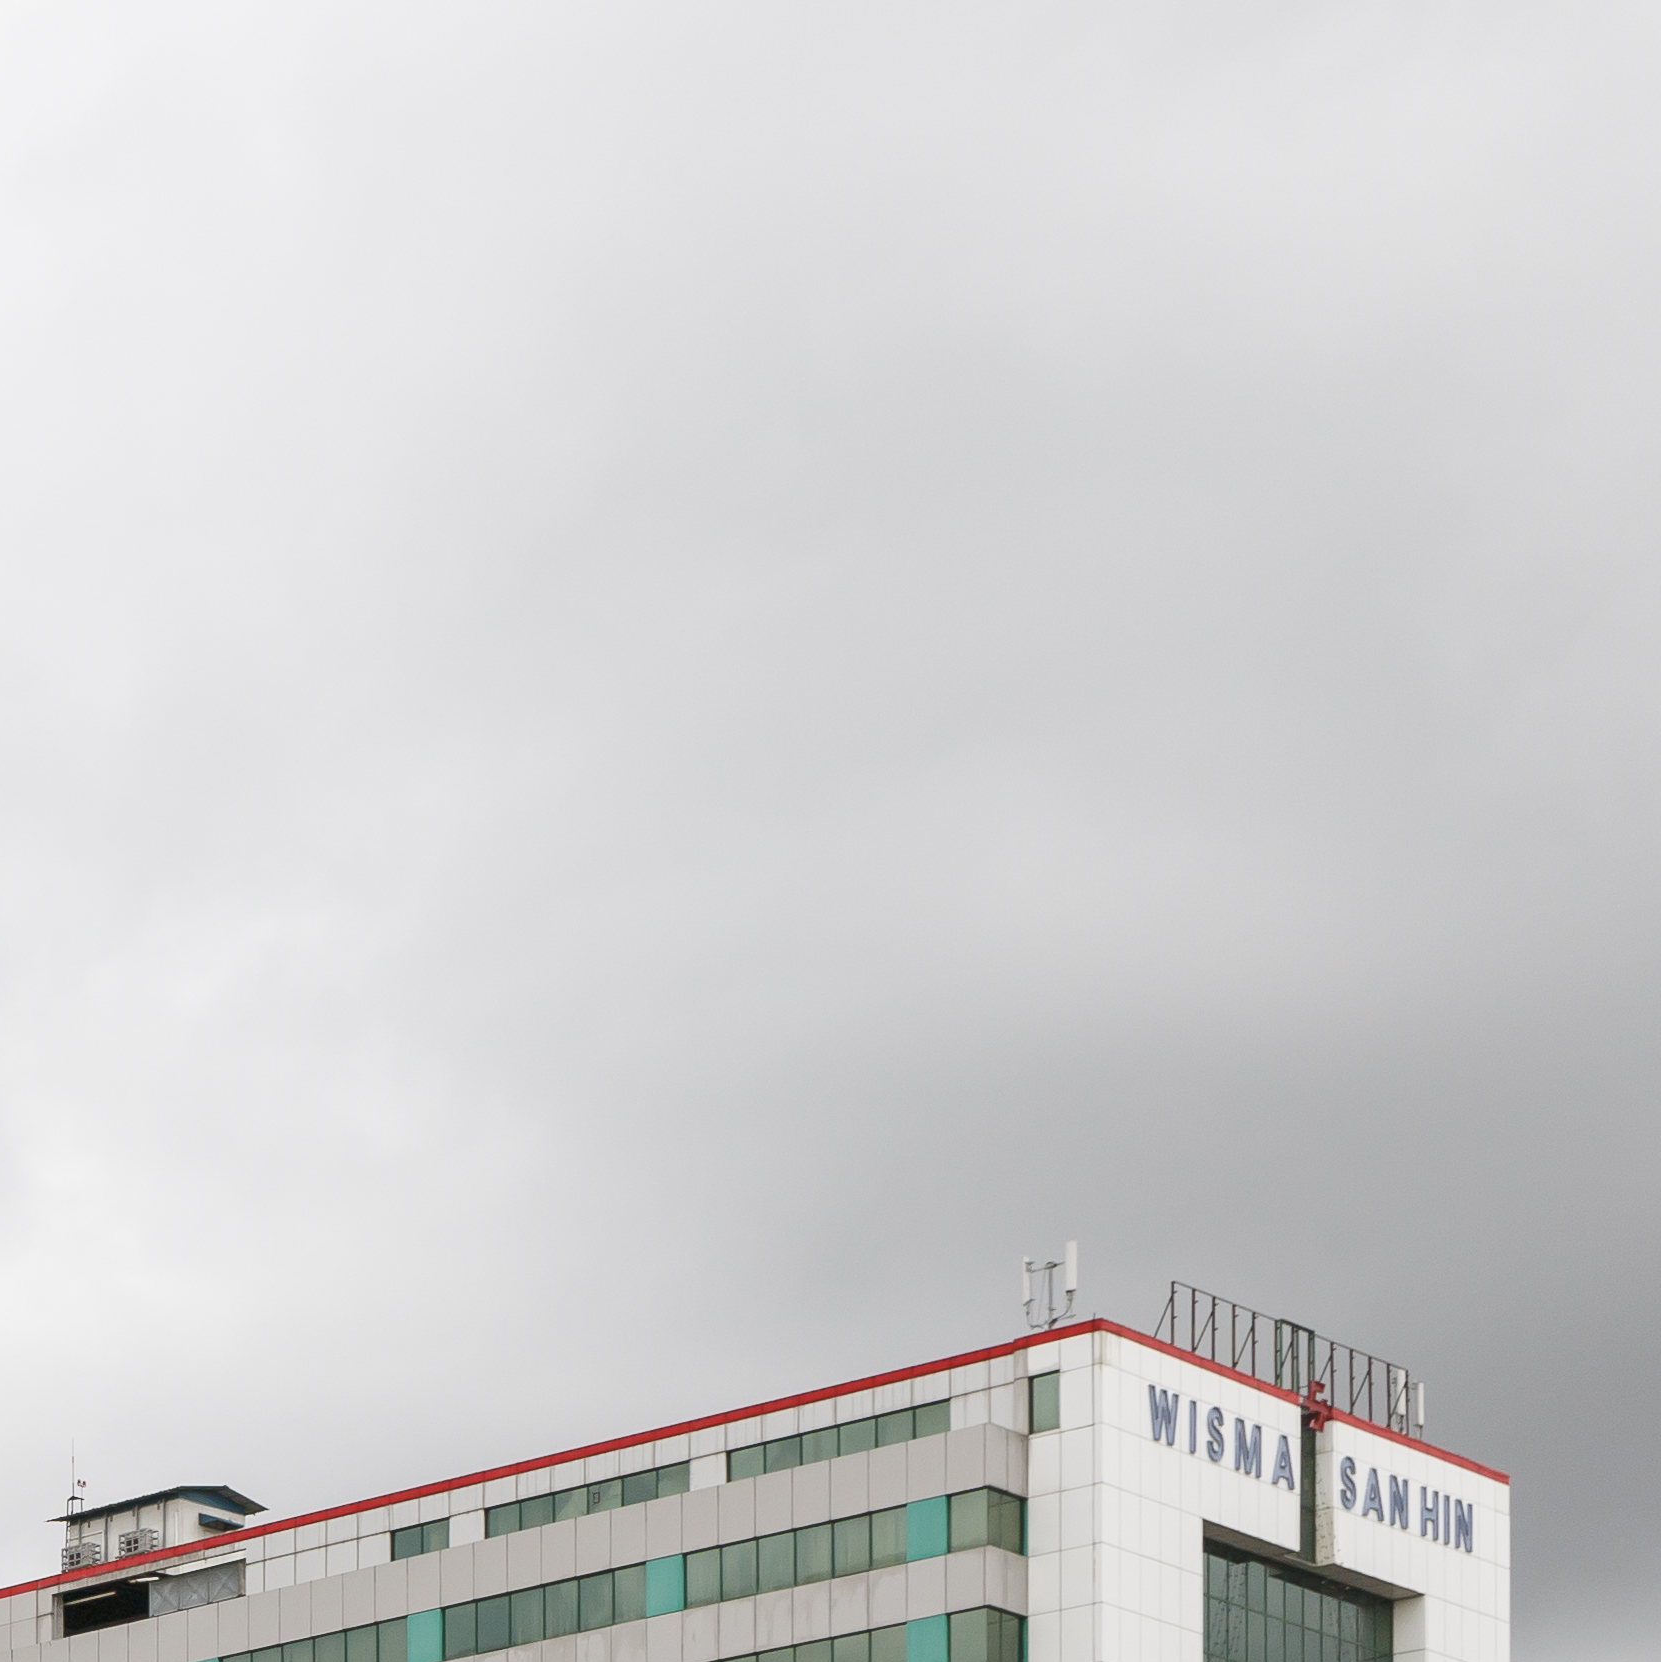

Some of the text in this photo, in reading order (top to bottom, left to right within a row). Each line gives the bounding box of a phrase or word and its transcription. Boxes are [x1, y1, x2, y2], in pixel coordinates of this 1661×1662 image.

[1148, 1383, 1474, 1553] WISMA SAN HIN
